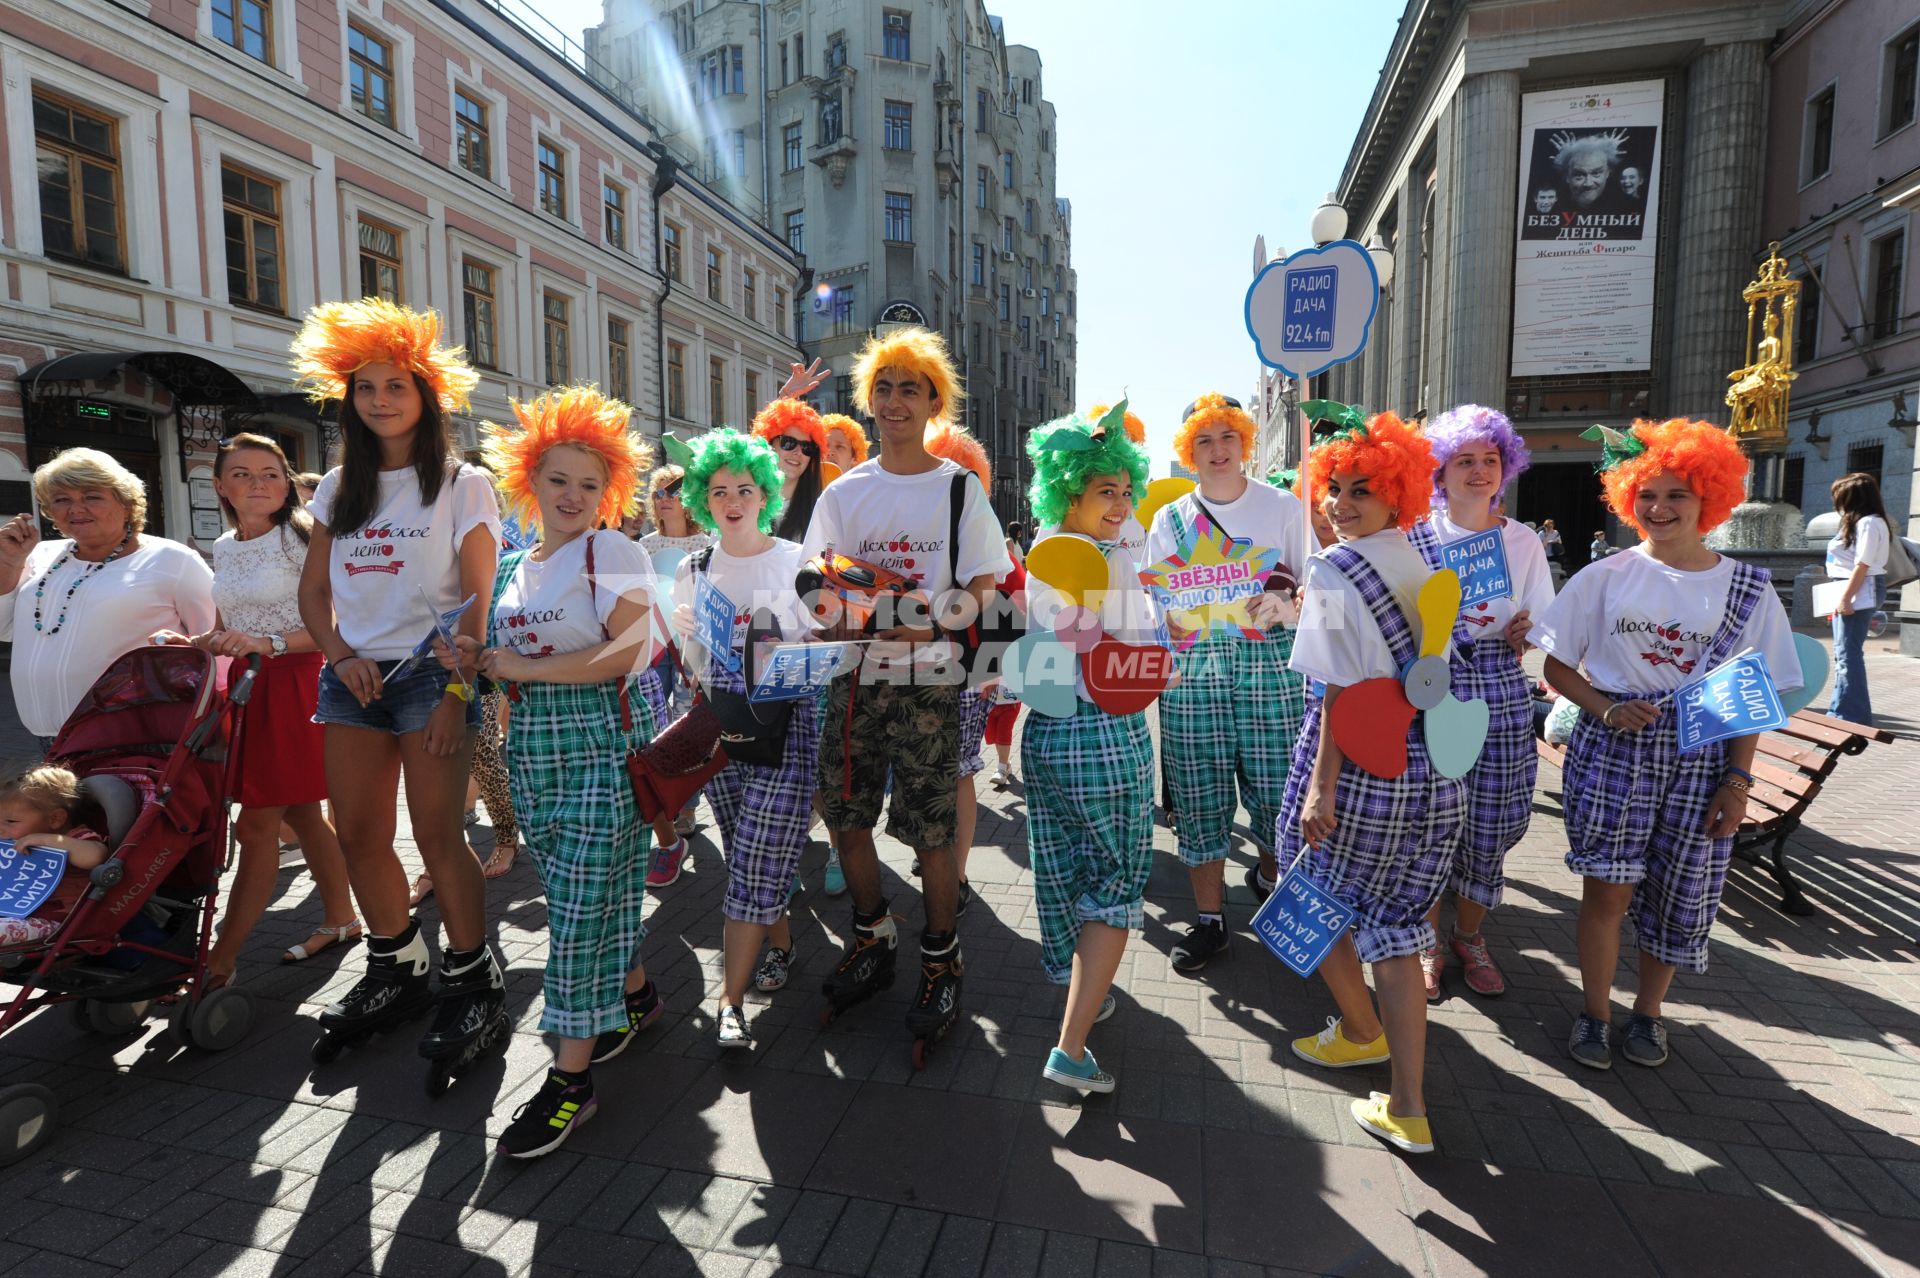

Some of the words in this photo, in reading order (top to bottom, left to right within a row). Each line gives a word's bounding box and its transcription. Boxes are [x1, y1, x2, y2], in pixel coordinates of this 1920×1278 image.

[1528, 211, 1641, 227] БЕЗУМНЫЙ
[1556, 227, 1607, 240] ДЕНЬ
[1536, 247, 1591, 258] Женитьба
[1593, 243, 1636, 254] Фигаро
[1291, 274, 1331, 292] РАДИО
[1293, 297, 1326, 314] ДАЧА
[1286, 323, 1313, 343] 92.4
[1315, 327, 1330, 342] fm
[1449, 536, 1496, 562] РАДИО
[1167, 561, 1249, 590] ЗВЁЗДЫ
[1458, 556, 1496, 579] ДАЧА
[700, 582, 729, 618] РАДИО
[1161, 588, 1216, 611] РАДИО
[1219, 581, 1264, 603] ДАЧА
[1462, 581, 1486, 601] 2.4
[1487, 579, 1505, 593] fm
[700, 602, 724, 632] ДАЧА
[715, 639, 727, 657] fm
[820, 648, 838, 665] fm
[760, 655, 792, 696] РАДИО
[782, 657, 809, 689] ДАЧА
[1712, 681, 1739, 723] ДАЧА
[1734, 665, 1770, 721] РАДИО
[1687, 721, 1703, 743] fm
[0, 860, 37, 900] ДАЧА
[15, 858, 58, 909] РАДИО
[109, 847, 172, 915] MACLAREN
[1289, 880, 1309, 902] fm
[1277, 907, 1319, 945] ДАЧА
[1307, 897, 1345, 931] 92.4
[1261, 919, 1310, 964] РАДИО
